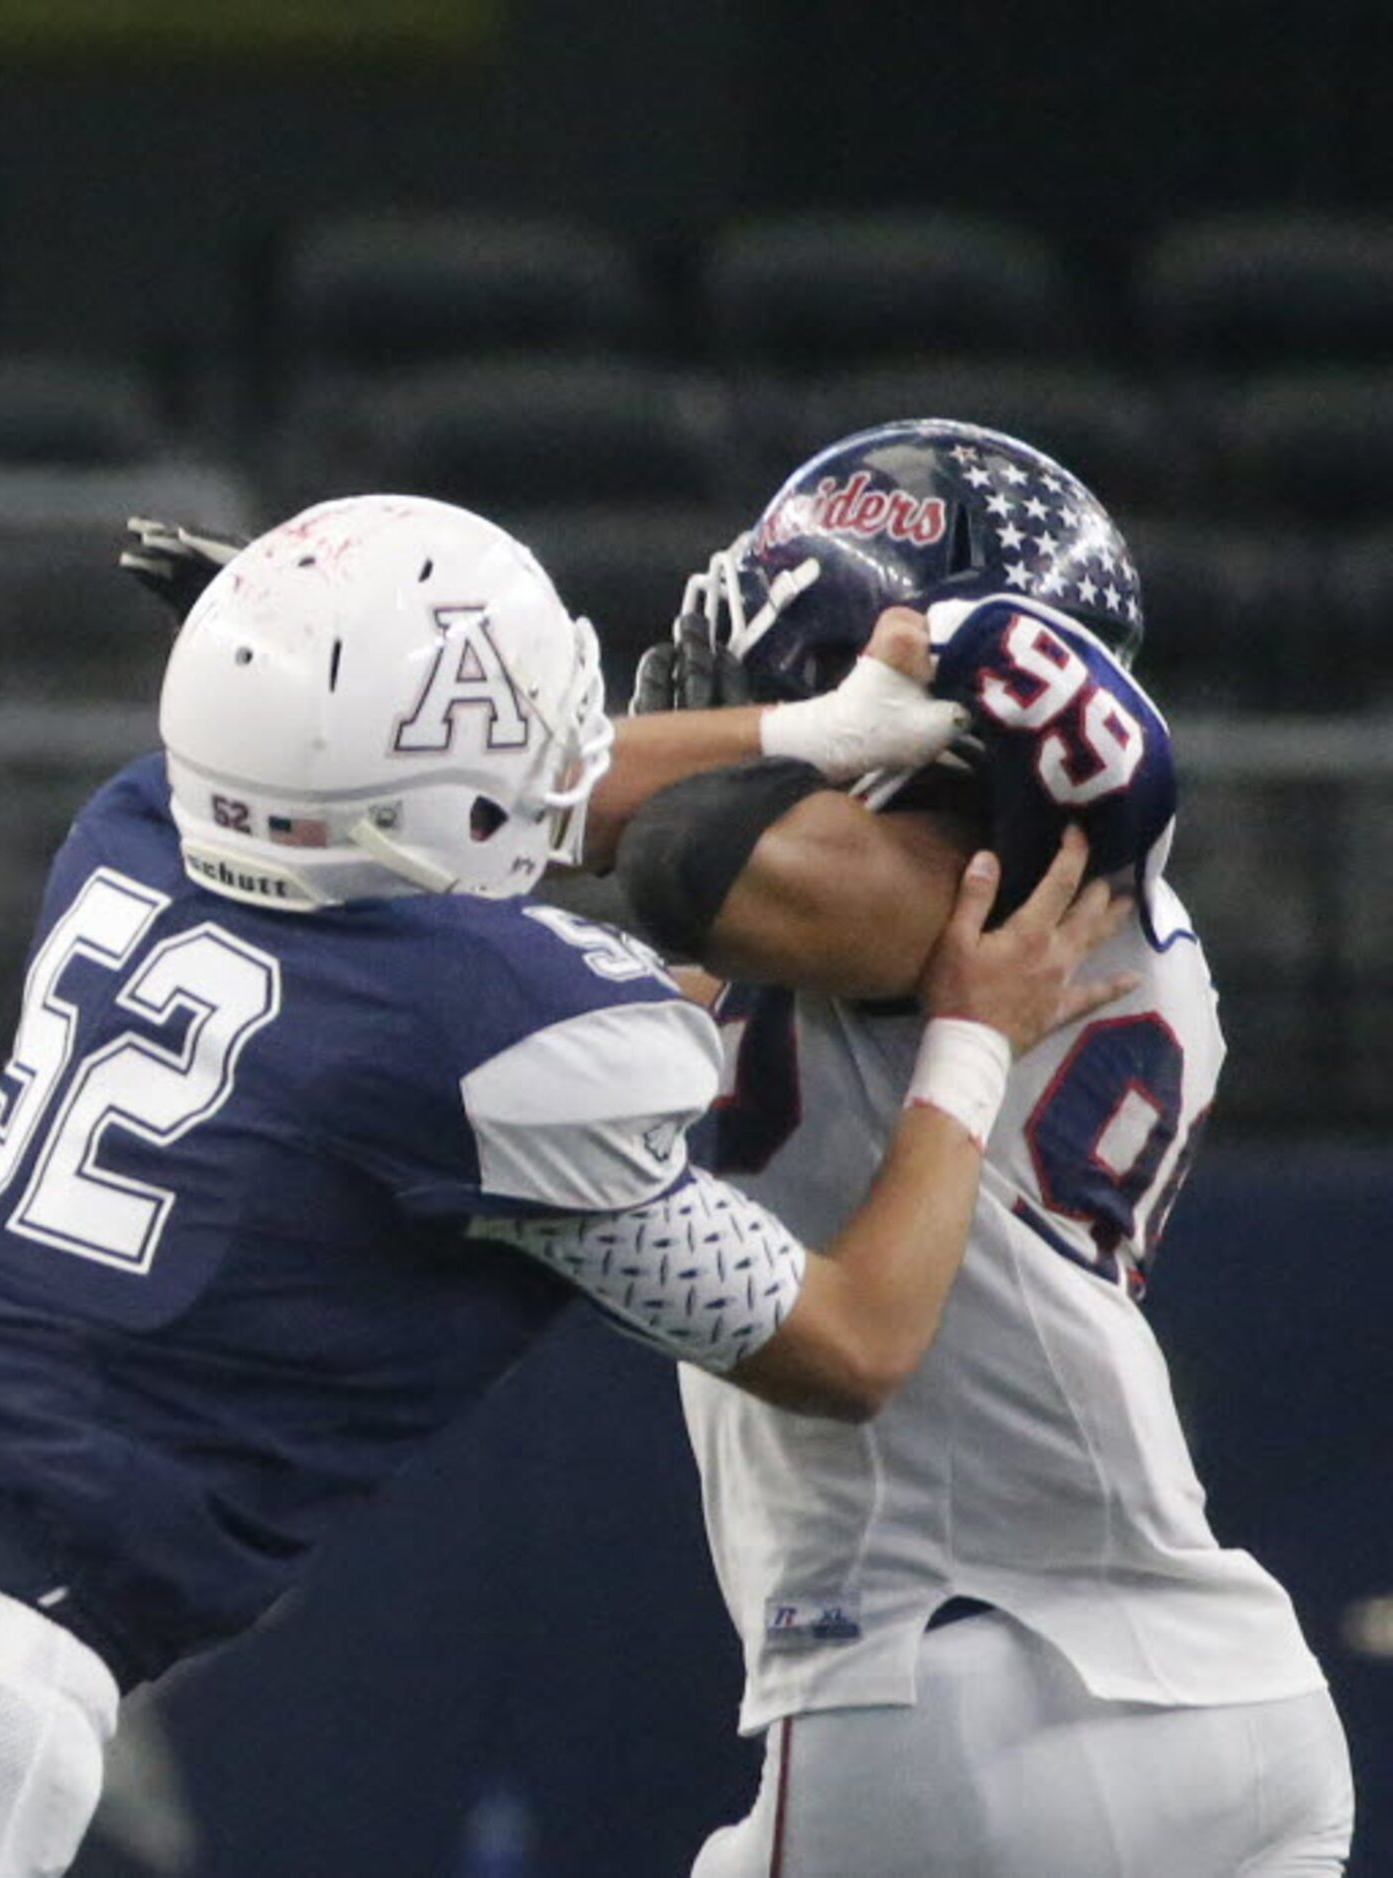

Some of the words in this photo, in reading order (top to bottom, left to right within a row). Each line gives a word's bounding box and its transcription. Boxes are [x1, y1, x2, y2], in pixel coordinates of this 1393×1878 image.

[391, 604, 529, 754] A
[975, 611, 1147, 808] 99
[210, 793, 254, 837] 52
